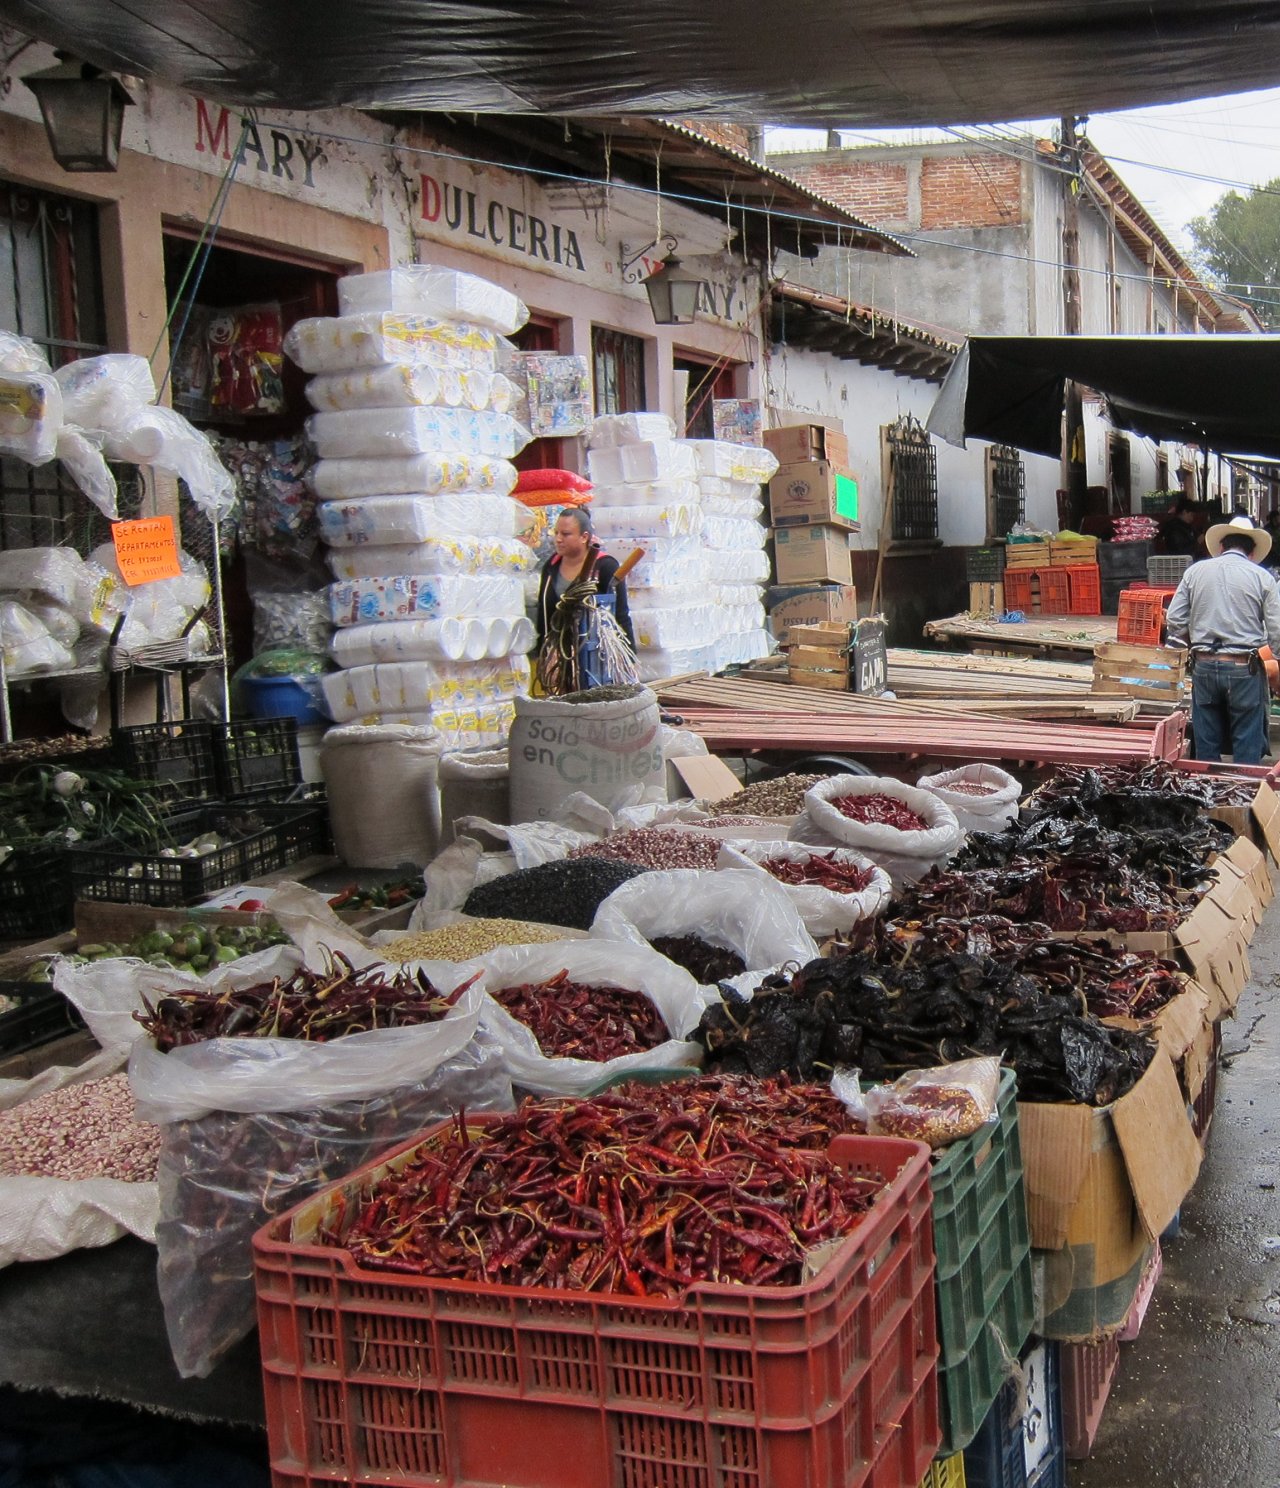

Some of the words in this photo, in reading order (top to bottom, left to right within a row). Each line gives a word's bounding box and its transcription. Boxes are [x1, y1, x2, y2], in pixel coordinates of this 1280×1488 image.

[195, 97, 322, 188] MARY
[420, 174, 586, 272] DULCERIA
[115, 526, 129, 538] SE
[116, 538, 175, 553] DEPARTAMENTOS
[528, 719, 579, 747] Solo
[523, 744, 554, 766] en
[556, 745, 663, 784] Chiles
